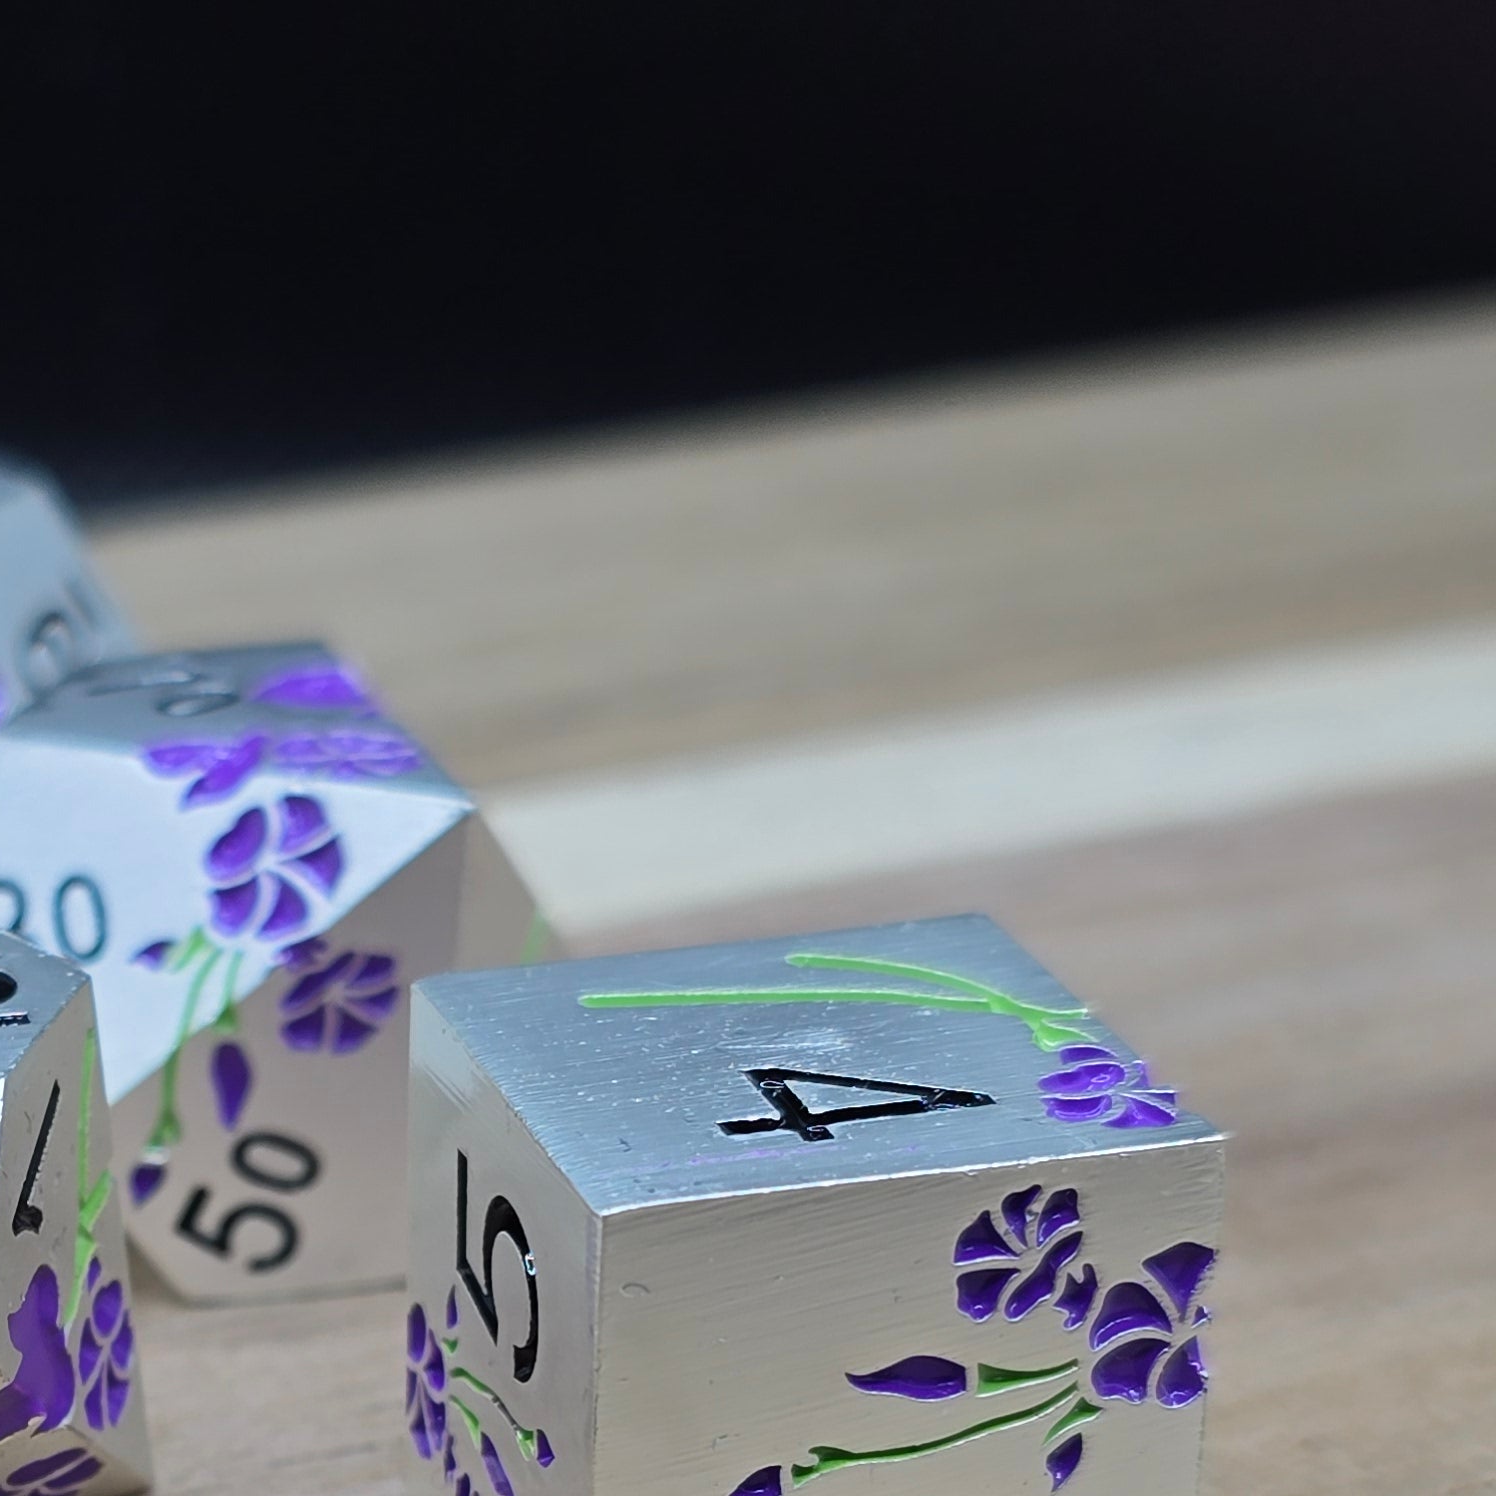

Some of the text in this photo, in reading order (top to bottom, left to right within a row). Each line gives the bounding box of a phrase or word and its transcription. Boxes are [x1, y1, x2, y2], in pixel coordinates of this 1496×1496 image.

[714, 1067, 998, 1143] 4
[172, 1130, 322, 1274] 50
[454, 1148, 539, 1385] 5
